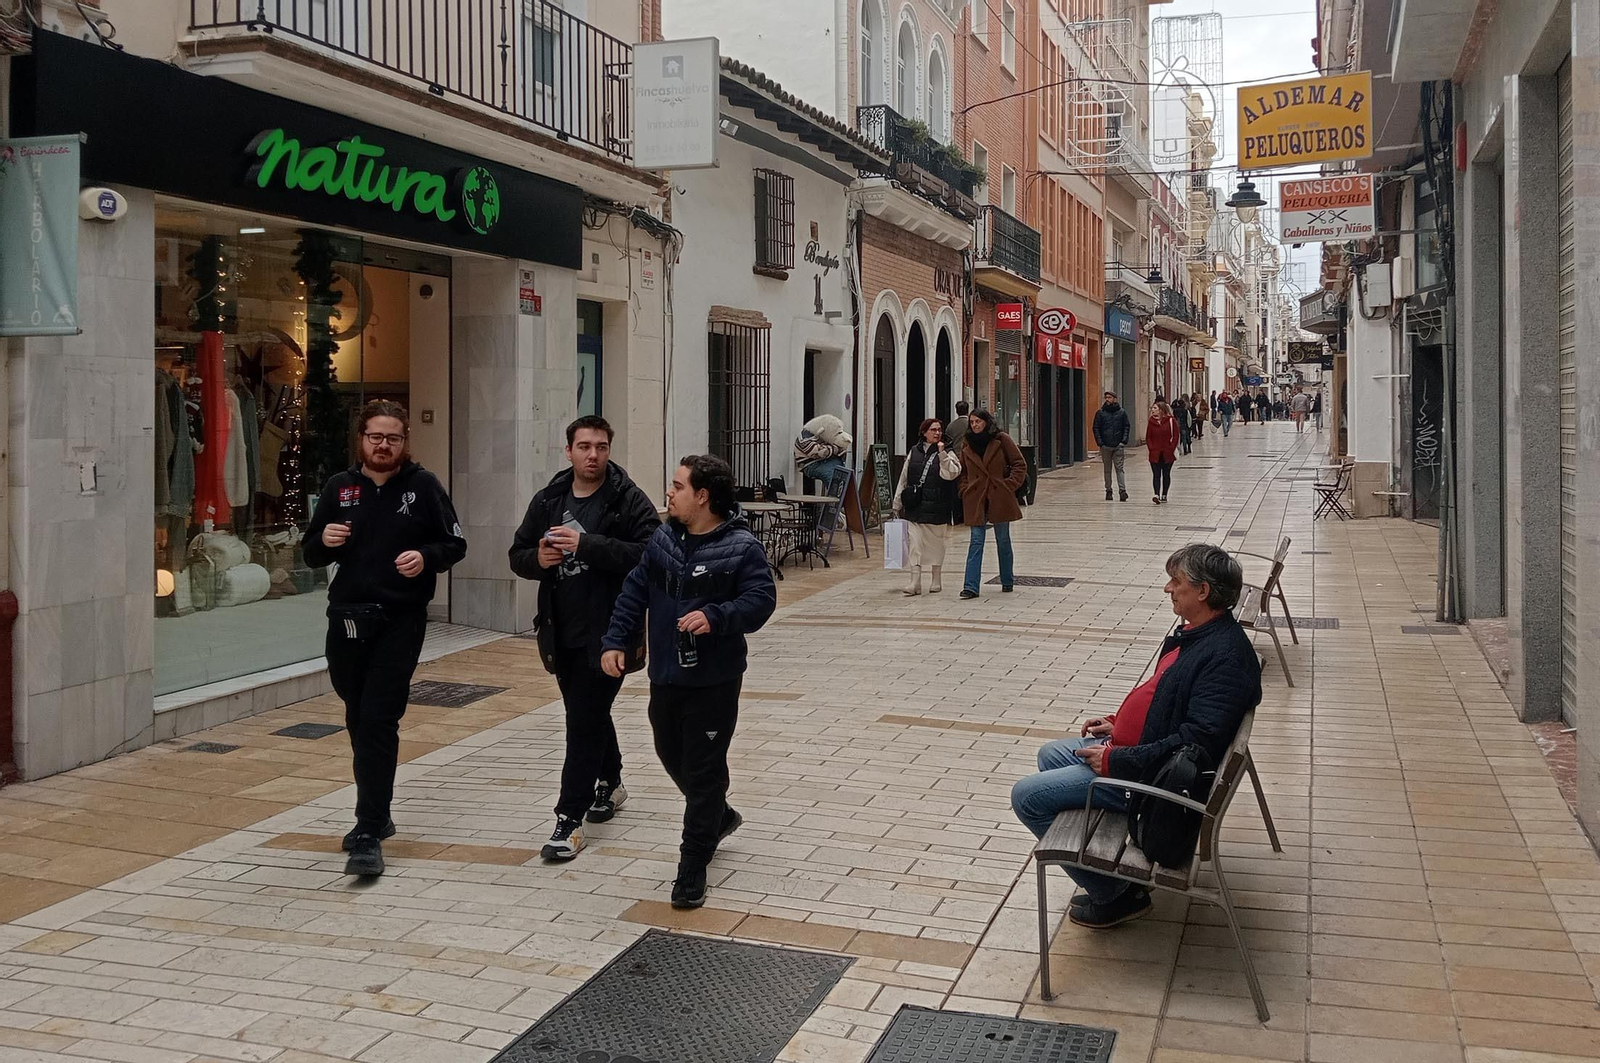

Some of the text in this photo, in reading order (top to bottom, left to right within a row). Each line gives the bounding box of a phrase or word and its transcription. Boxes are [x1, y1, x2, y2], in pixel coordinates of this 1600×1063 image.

[1242, 85, 1365, 125] ALDEMAR
[1245, 124, 1366, 160] PELUQUEROS
[257, 128, 456, 222] natura
[101, 199, 115, 209] ADT
[1283, 192, 1371, 209] PELUQUERIA
[1283, 222, 1373, 240] Caballeros y Niños
[997, 311, 1021, 320] GAES
